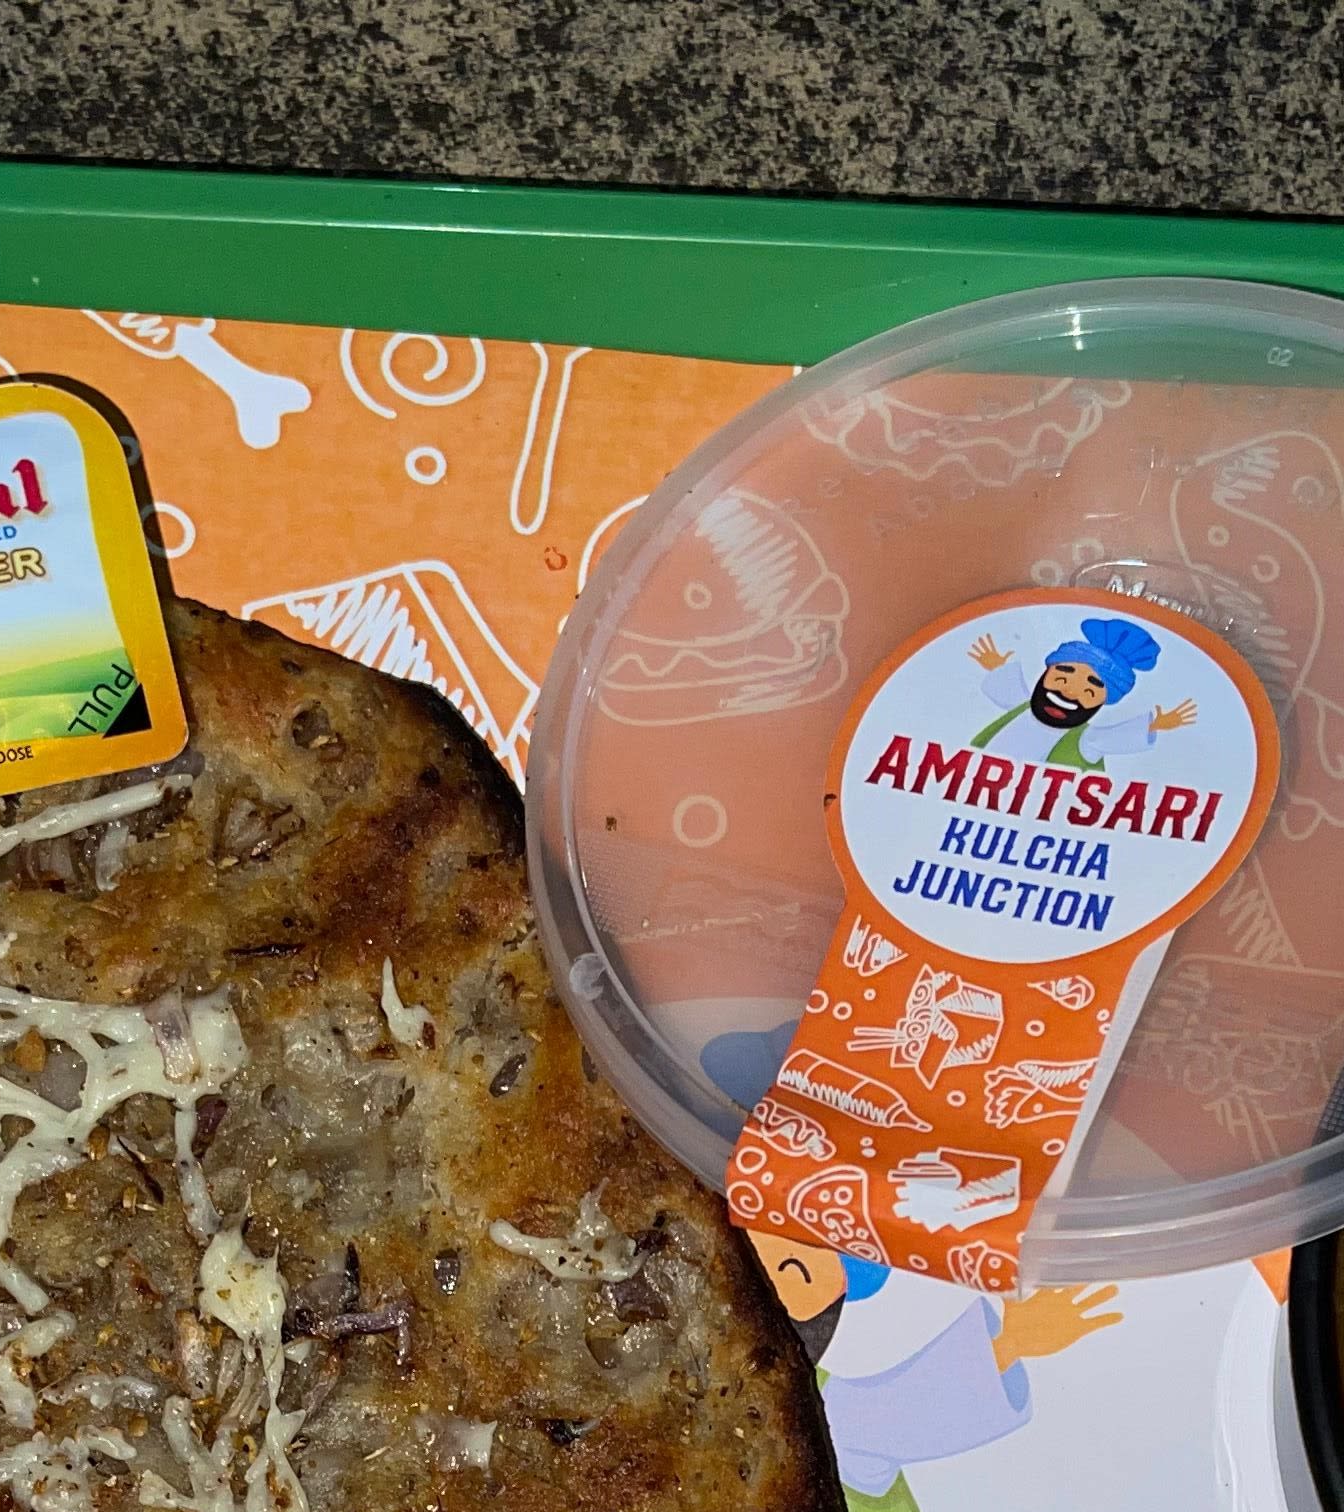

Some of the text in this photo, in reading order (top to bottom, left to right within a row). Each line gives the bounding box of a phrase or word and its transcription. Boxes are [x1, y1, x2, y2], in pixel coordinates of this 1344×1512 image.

[67, 663, 134, 733] PULL
[864, 734, 1223, 842] AMRITSARI
[939, 816, 1110, 880] KULCHA
[892, 859, 1115, 932] JUNCTION
